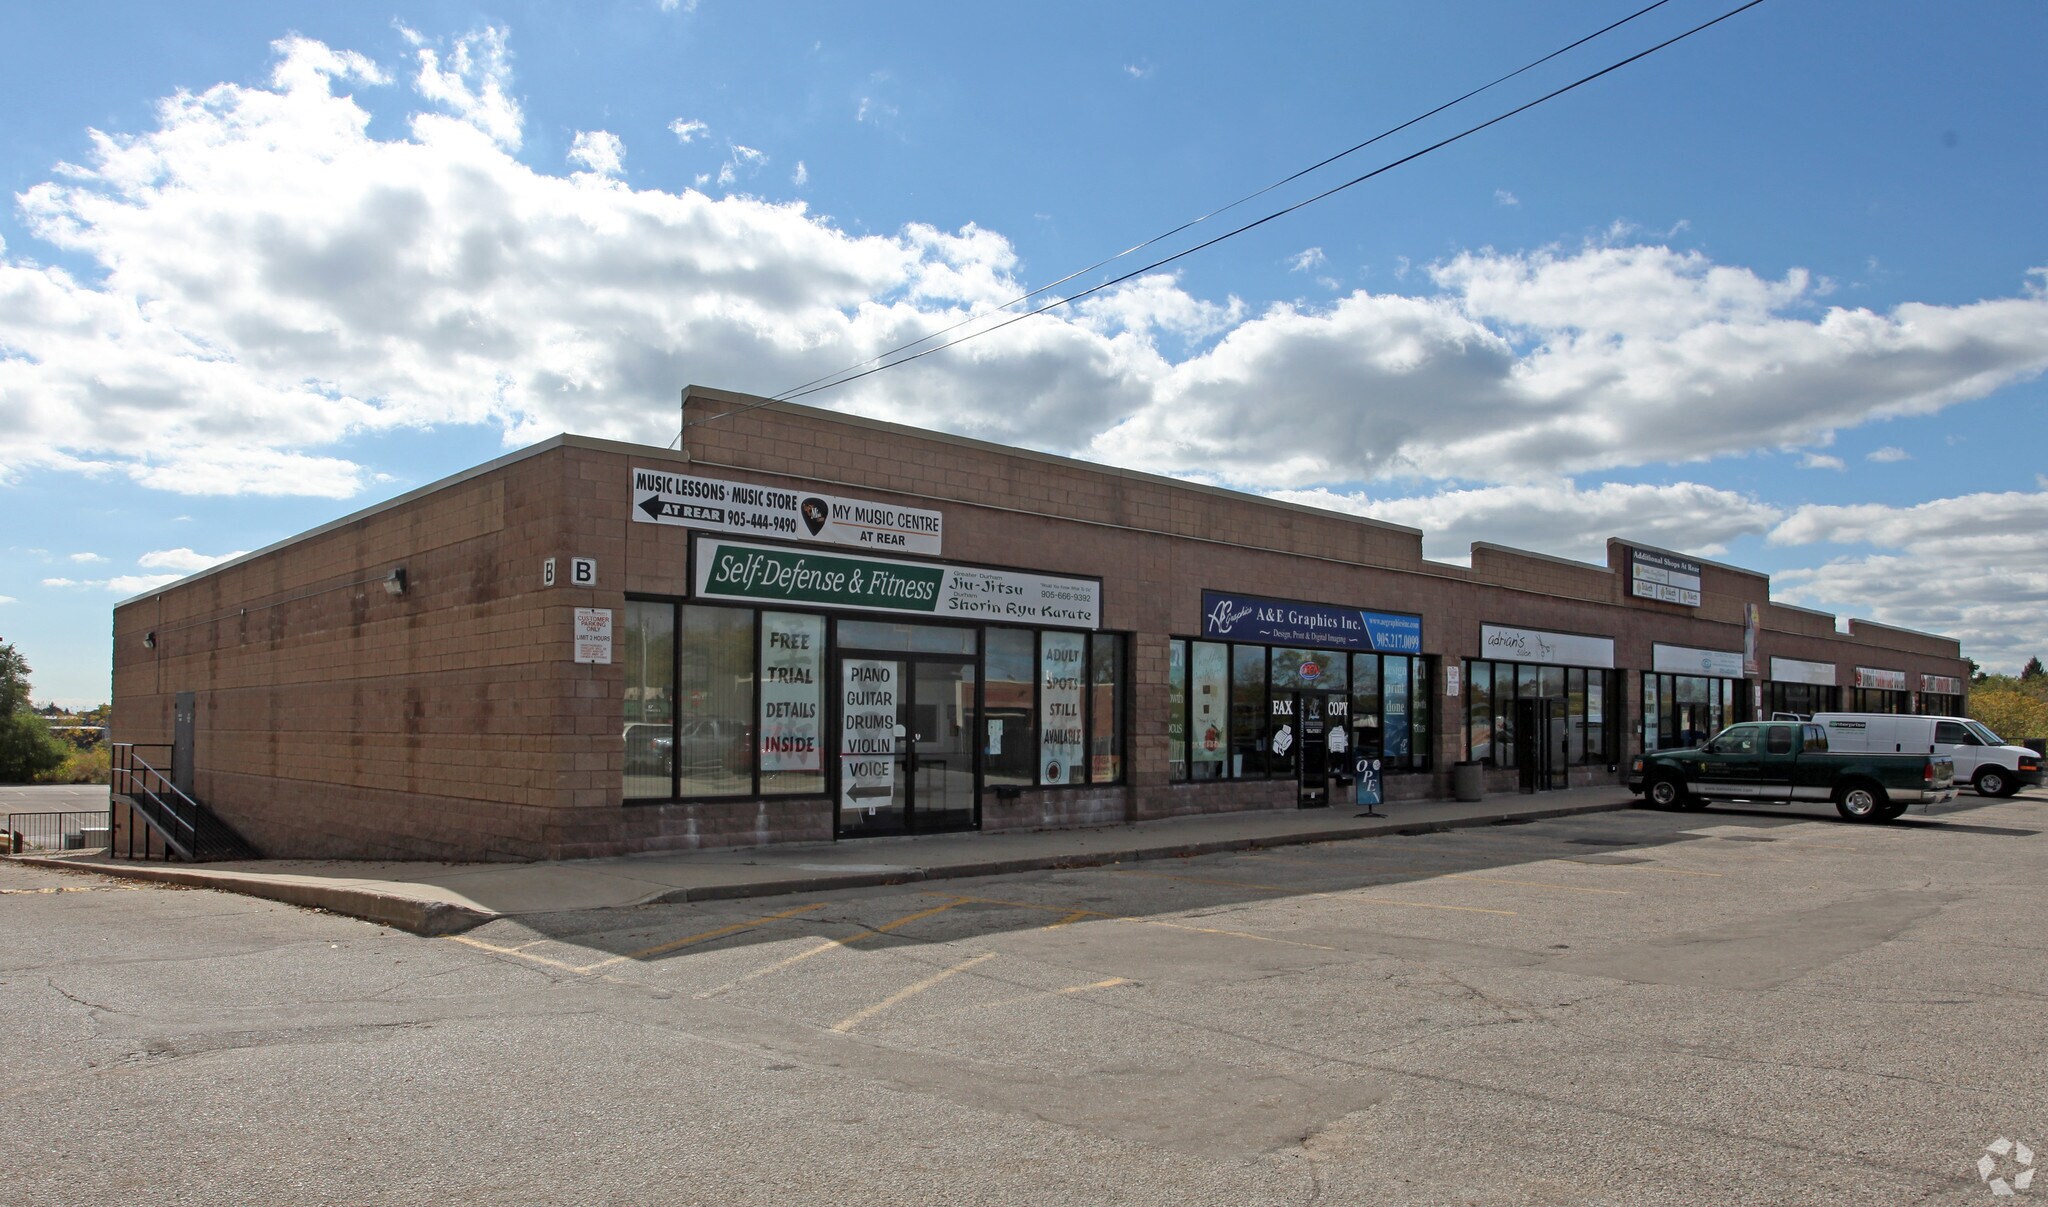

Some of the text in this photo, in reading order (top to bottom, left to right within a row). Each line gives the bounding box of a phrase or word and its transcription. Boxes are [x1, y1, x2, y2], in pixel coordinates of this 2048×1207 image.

[636, 473, 672, 494] MUSIC
[676, 478, 725, 500] LESSONS
[732, 487, 763, 506] MUSIC
[766, 492, 797, 511] STORE
[662, 504, 720, 520] AT REAR
[832, 504, 851, 520] MY
[855, 507, 894, 526] MUSIC
[898, 513, 938, 532] CENTRE
[728, 510, 796, 533] 905-444-9490
[860, 531, 905, 546] AT REAR
[1634, 551, 1663, 564] Additional
[1664, 558, 1680, 568] Shops
[546, 563, 553, 582] B
[577, 562, 591, 581] B
[716, 554, 934, 600] Self-Defense & Fitness
[949, 578, 1023, 596] Jiu-Jitsu
[1041, 590, 1090, 602] 905-666-9392
[948, 598, 1091, 620] Shorin Ryu Karate
[1256, 608, 1360, 630] A&E Graphics Inc.
[770, 632, 810, 650] FREE
[1293, 630, 1304, 639] Print
[1311, 632, 1327, 642] Digital
[1328, 634, 1346, 644] Imaging
[1376, 632, 1419, 650] 905.217.0099
[1488, 632, 1525, 648] adrian's
[1046, 649, 1079, 662] ADULT
[768, 666, 813, 684] TRIAL
[851, 668, 890, 682] PIANO
[1046, 678, 1078, 690] SPOTS
[847, 692, 892, 706] GUITAR
[1272, 700, 1293, 714] FAX
[1386, 700, 1404, 712] done
[766, 702, 816, 718] DETAILS
[1050, 703, 1077, 716] STILL
[1328, 702, 1348, 716] COPY
[846, 715, 894, 730] DRUMS
[766, 736, 814, 752] INSIDE
[1044, 728, 1081, 745] AVAILABLE
[848, 738, 890, 752] VIOLIN
[850, 762, 889, 776] VOICE
